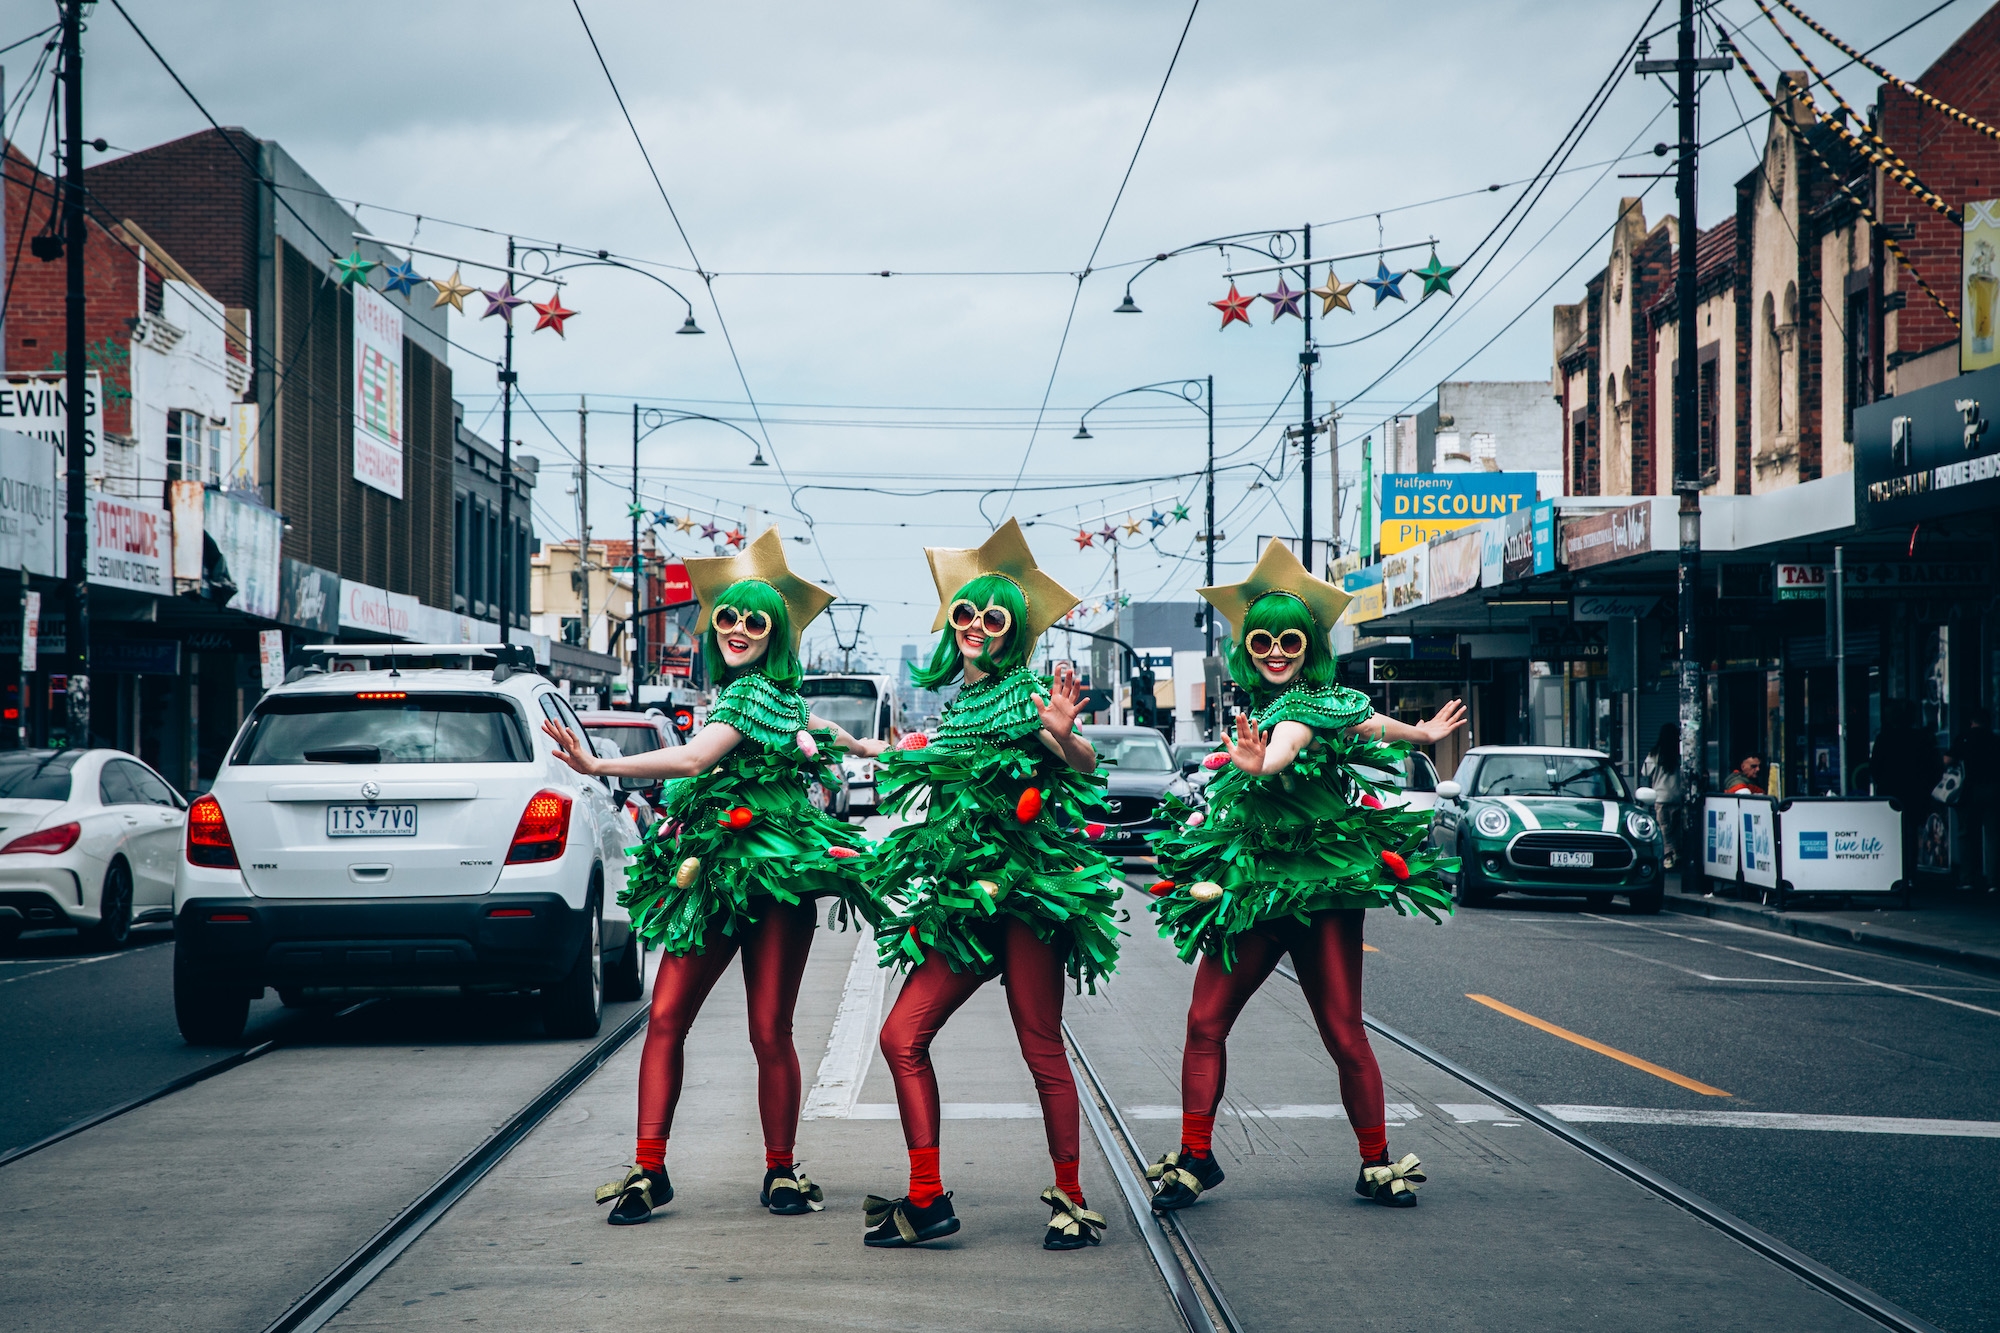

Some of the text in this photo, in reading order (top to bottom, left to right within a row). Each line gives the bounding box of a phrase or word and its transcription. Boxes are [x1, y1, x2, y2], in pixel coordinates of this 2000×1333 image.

[1395, 477, 1453, 490] Halfpenny
[1394, 493, 1522, 514] DISCOUNT
[97, 501, 159, 558] STATEWIDE
[1612, 513, 1627, 553] Food
[1505, 518, 1533, 564] Smoke
[98, 556, 160, 586] SEWING CENTRE
[1781, 590, 1798, 600] DAILY
[350, 588, 408, 632] Costanzo
[1560, 645, 1599, 656] BREAD
[333, 809, 413, 829] 1TS 7VQ
[1835, 837, 1884, 853] live life
[1552, 853, 1568, 863] 1XB
